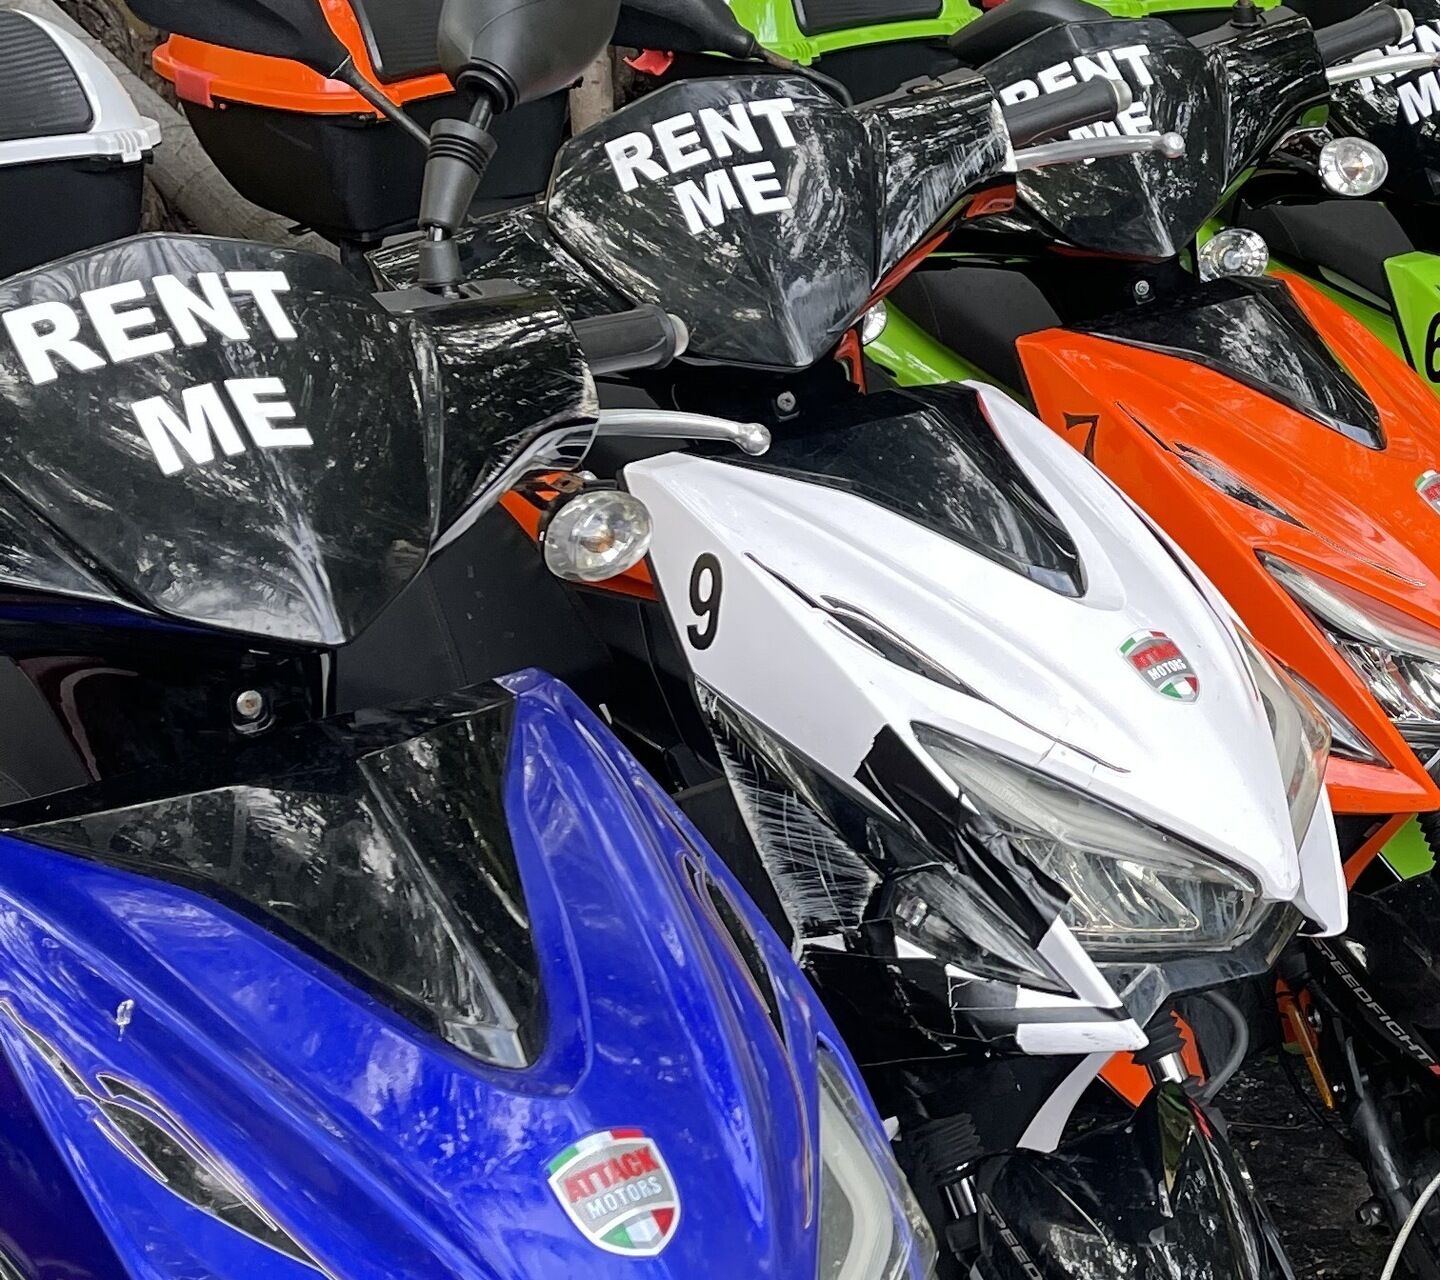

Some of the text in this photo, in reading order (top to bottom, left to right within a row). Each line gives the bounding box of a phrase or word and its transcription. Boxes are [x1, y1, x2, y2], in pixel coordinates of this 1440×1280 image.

[604, 97, 798, 193] RENT
[673, 160, 793, 235] ME
[1, 270, 299, 386] RENT
[130, 376, 314, 477] ME
[1062, 411, 1100, 466] 7
[687, 552, 724, 651] 9
[1147, 658, 1187, 681] MOTORS
[563, 1144, 661, 1204] ATTACK
[585, 1175, 664, 1220] MOTORS
